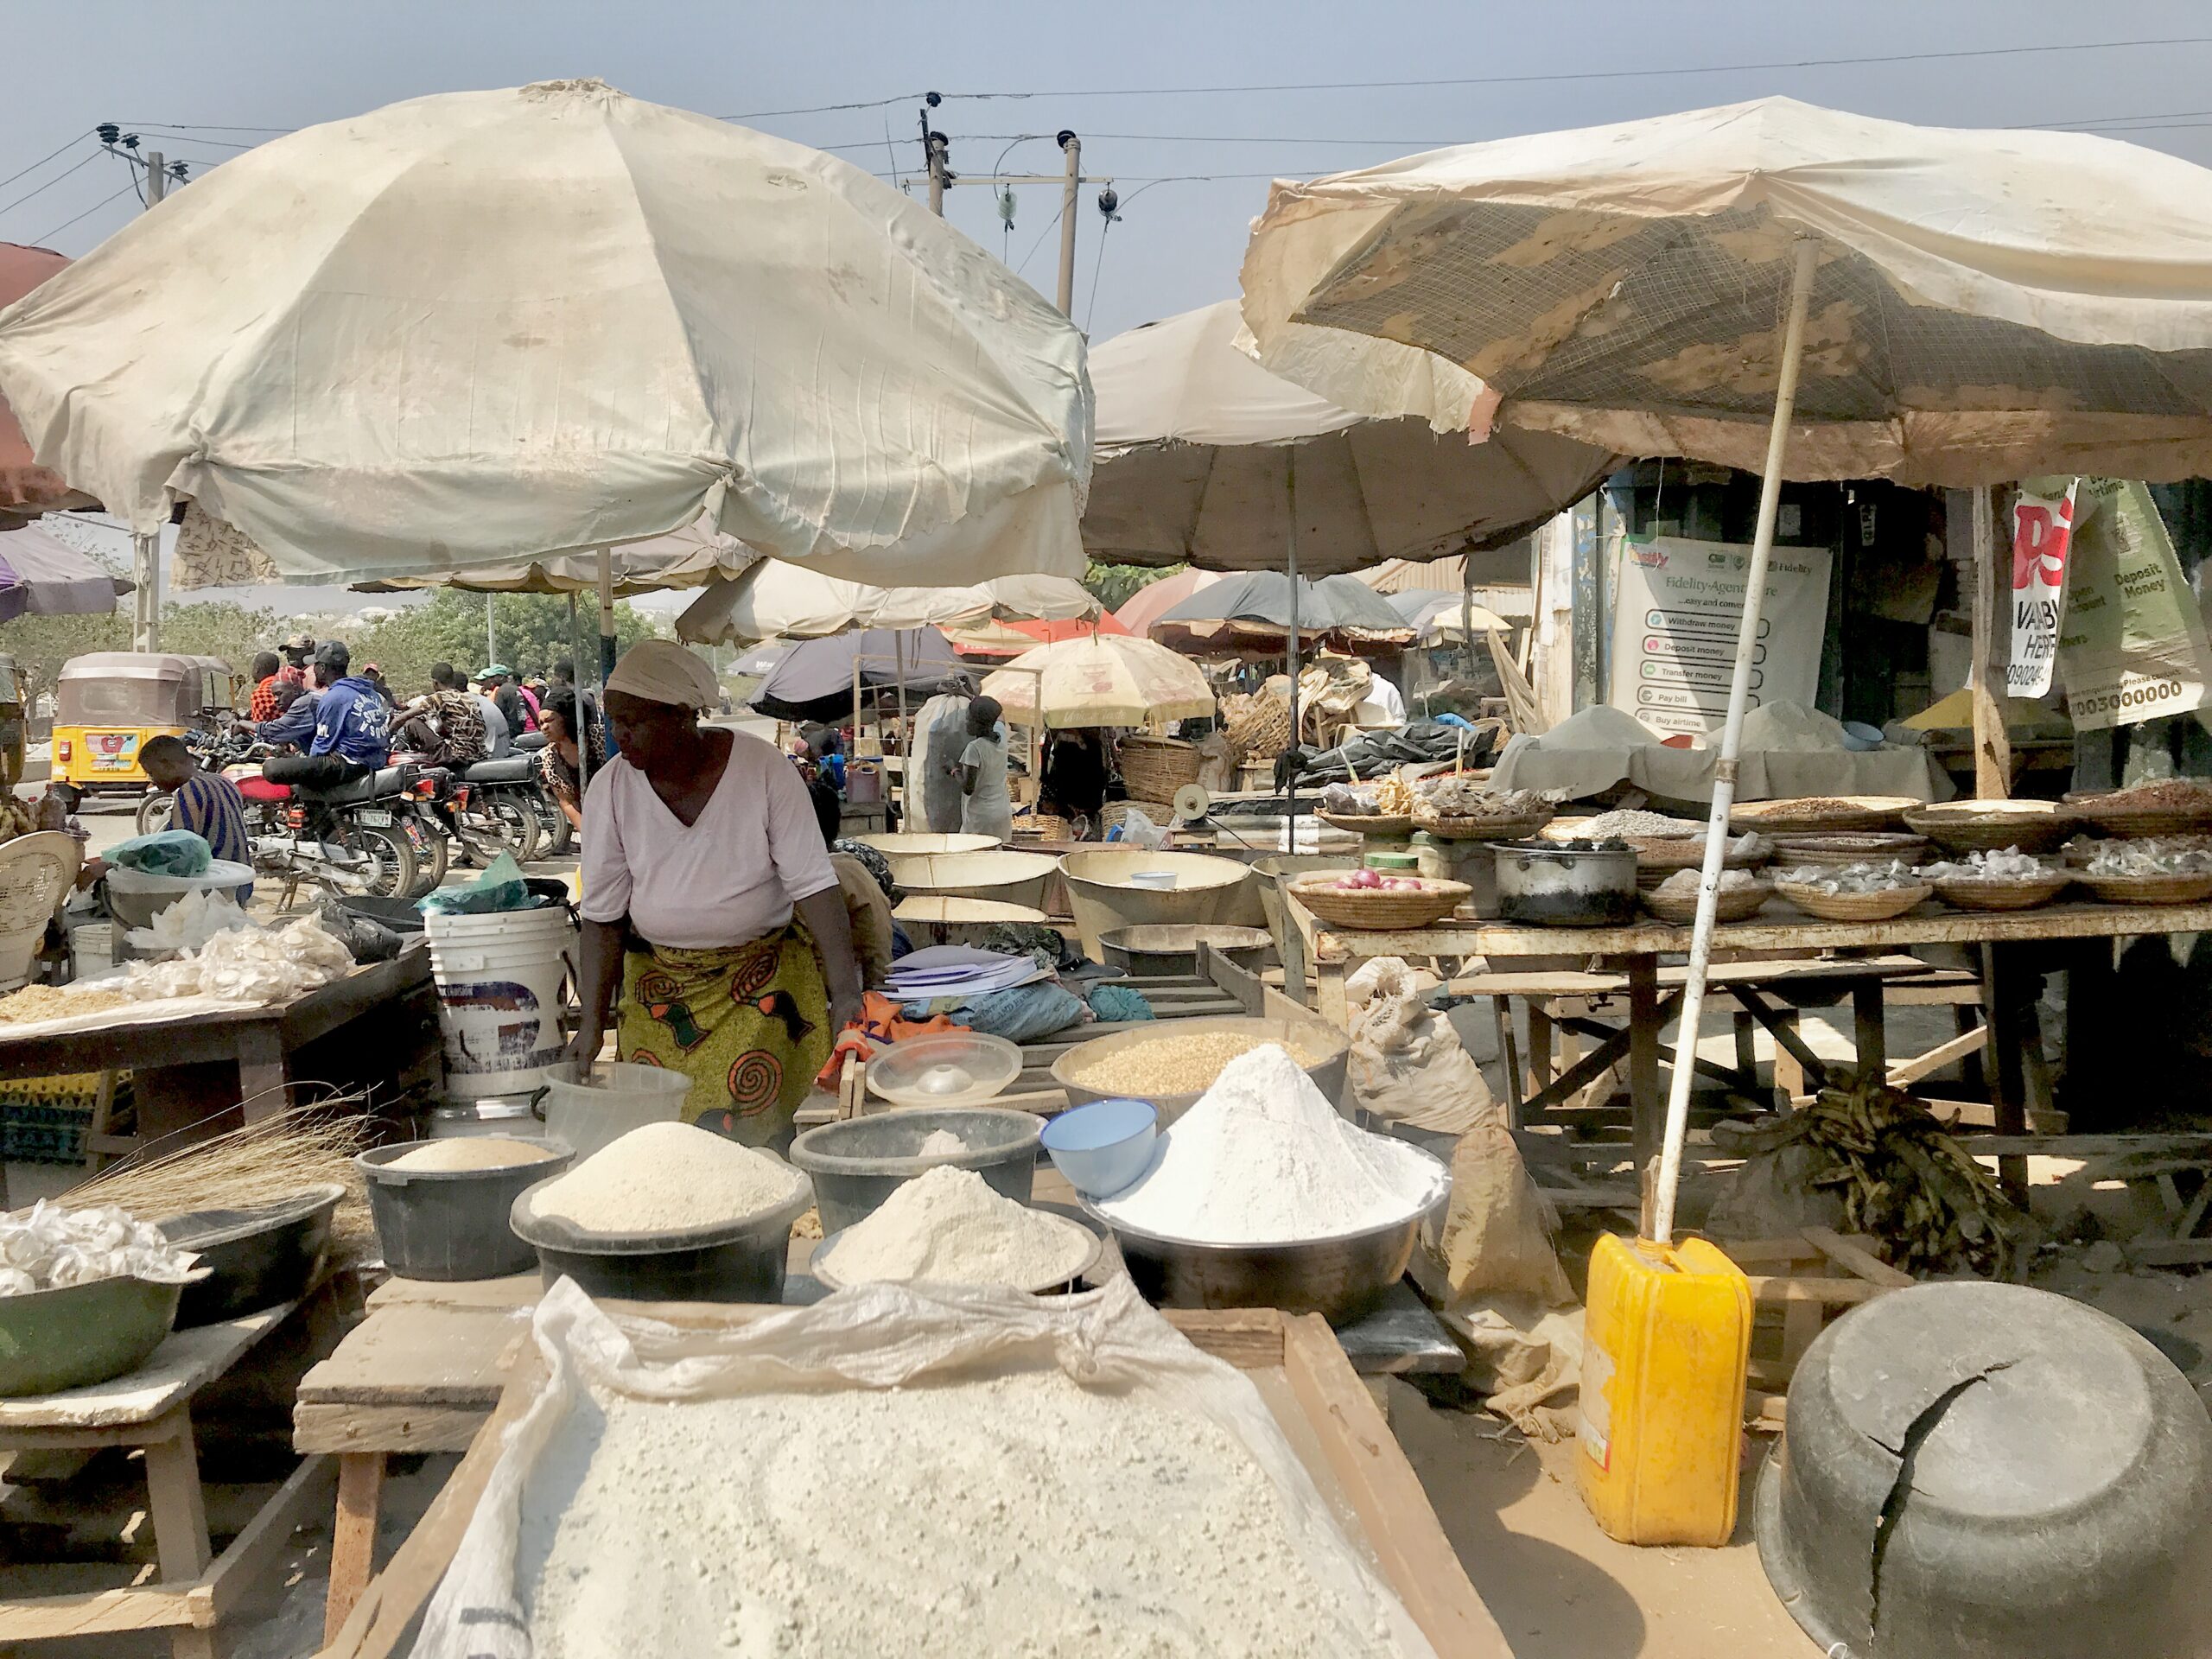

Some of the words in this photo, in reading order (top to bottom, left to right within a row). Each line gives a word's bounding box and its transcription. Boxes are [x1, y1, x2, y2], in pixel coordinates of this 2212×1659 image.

[1779, 563, 1813, 574] Fidelity
[2113, 563, 2162, 586] Deposit
[2124, 579, 2165, 598] Money
[1668, 617, 1707, 628] Withdraw
[1708, 621, 1736, 631] money
[1664, 643, 1695, 653] Deposit
[1697, 646, 1725, 656] money
[1662, 668, 1694, 678] Transfer
[1695, 672, 1723, 681] money
[2124, 676, 2152, 687] Please
[1658, 694, 1673, 703] Pay
[1675, 695, 1688, 703] bill
[1656, 716, 1671, 726] Buy
[1673, 718, 1701, 728] airtime
